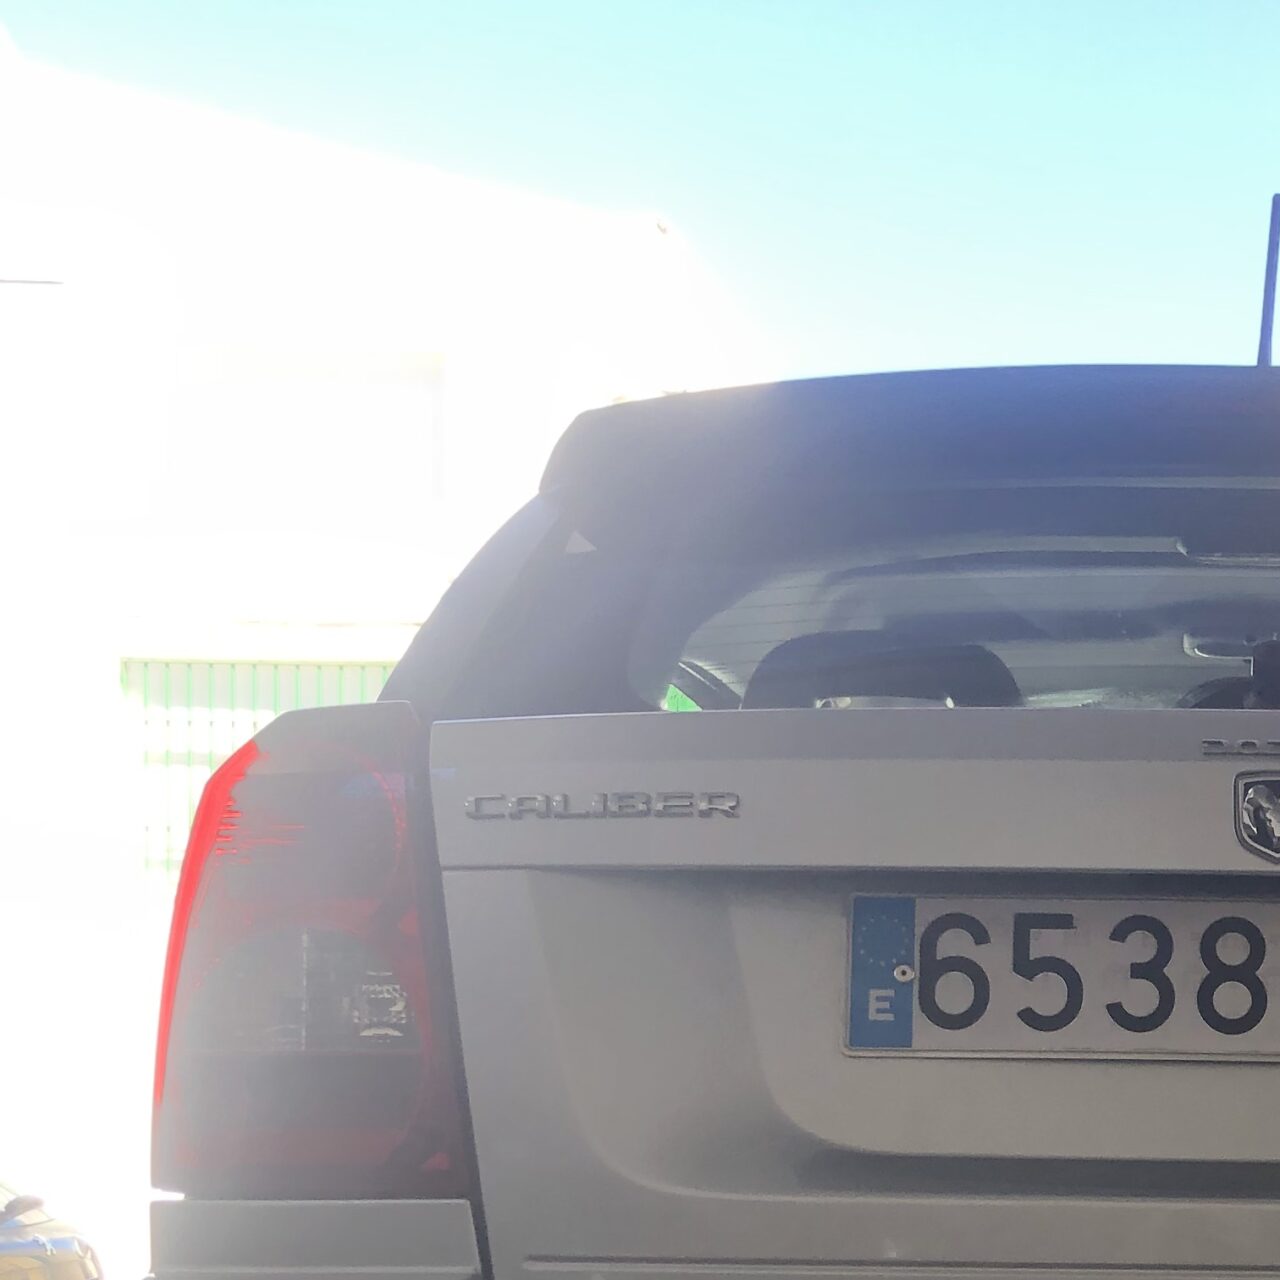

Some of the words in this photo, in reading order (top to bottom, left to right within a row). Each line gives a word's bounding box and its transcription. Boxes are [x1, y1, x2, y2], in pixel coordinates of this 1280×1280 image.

[465, 792, 741, 820] CALIBER
[869, 989, 896, 1021] E
[917, 911, 1269, 1036] 6538
